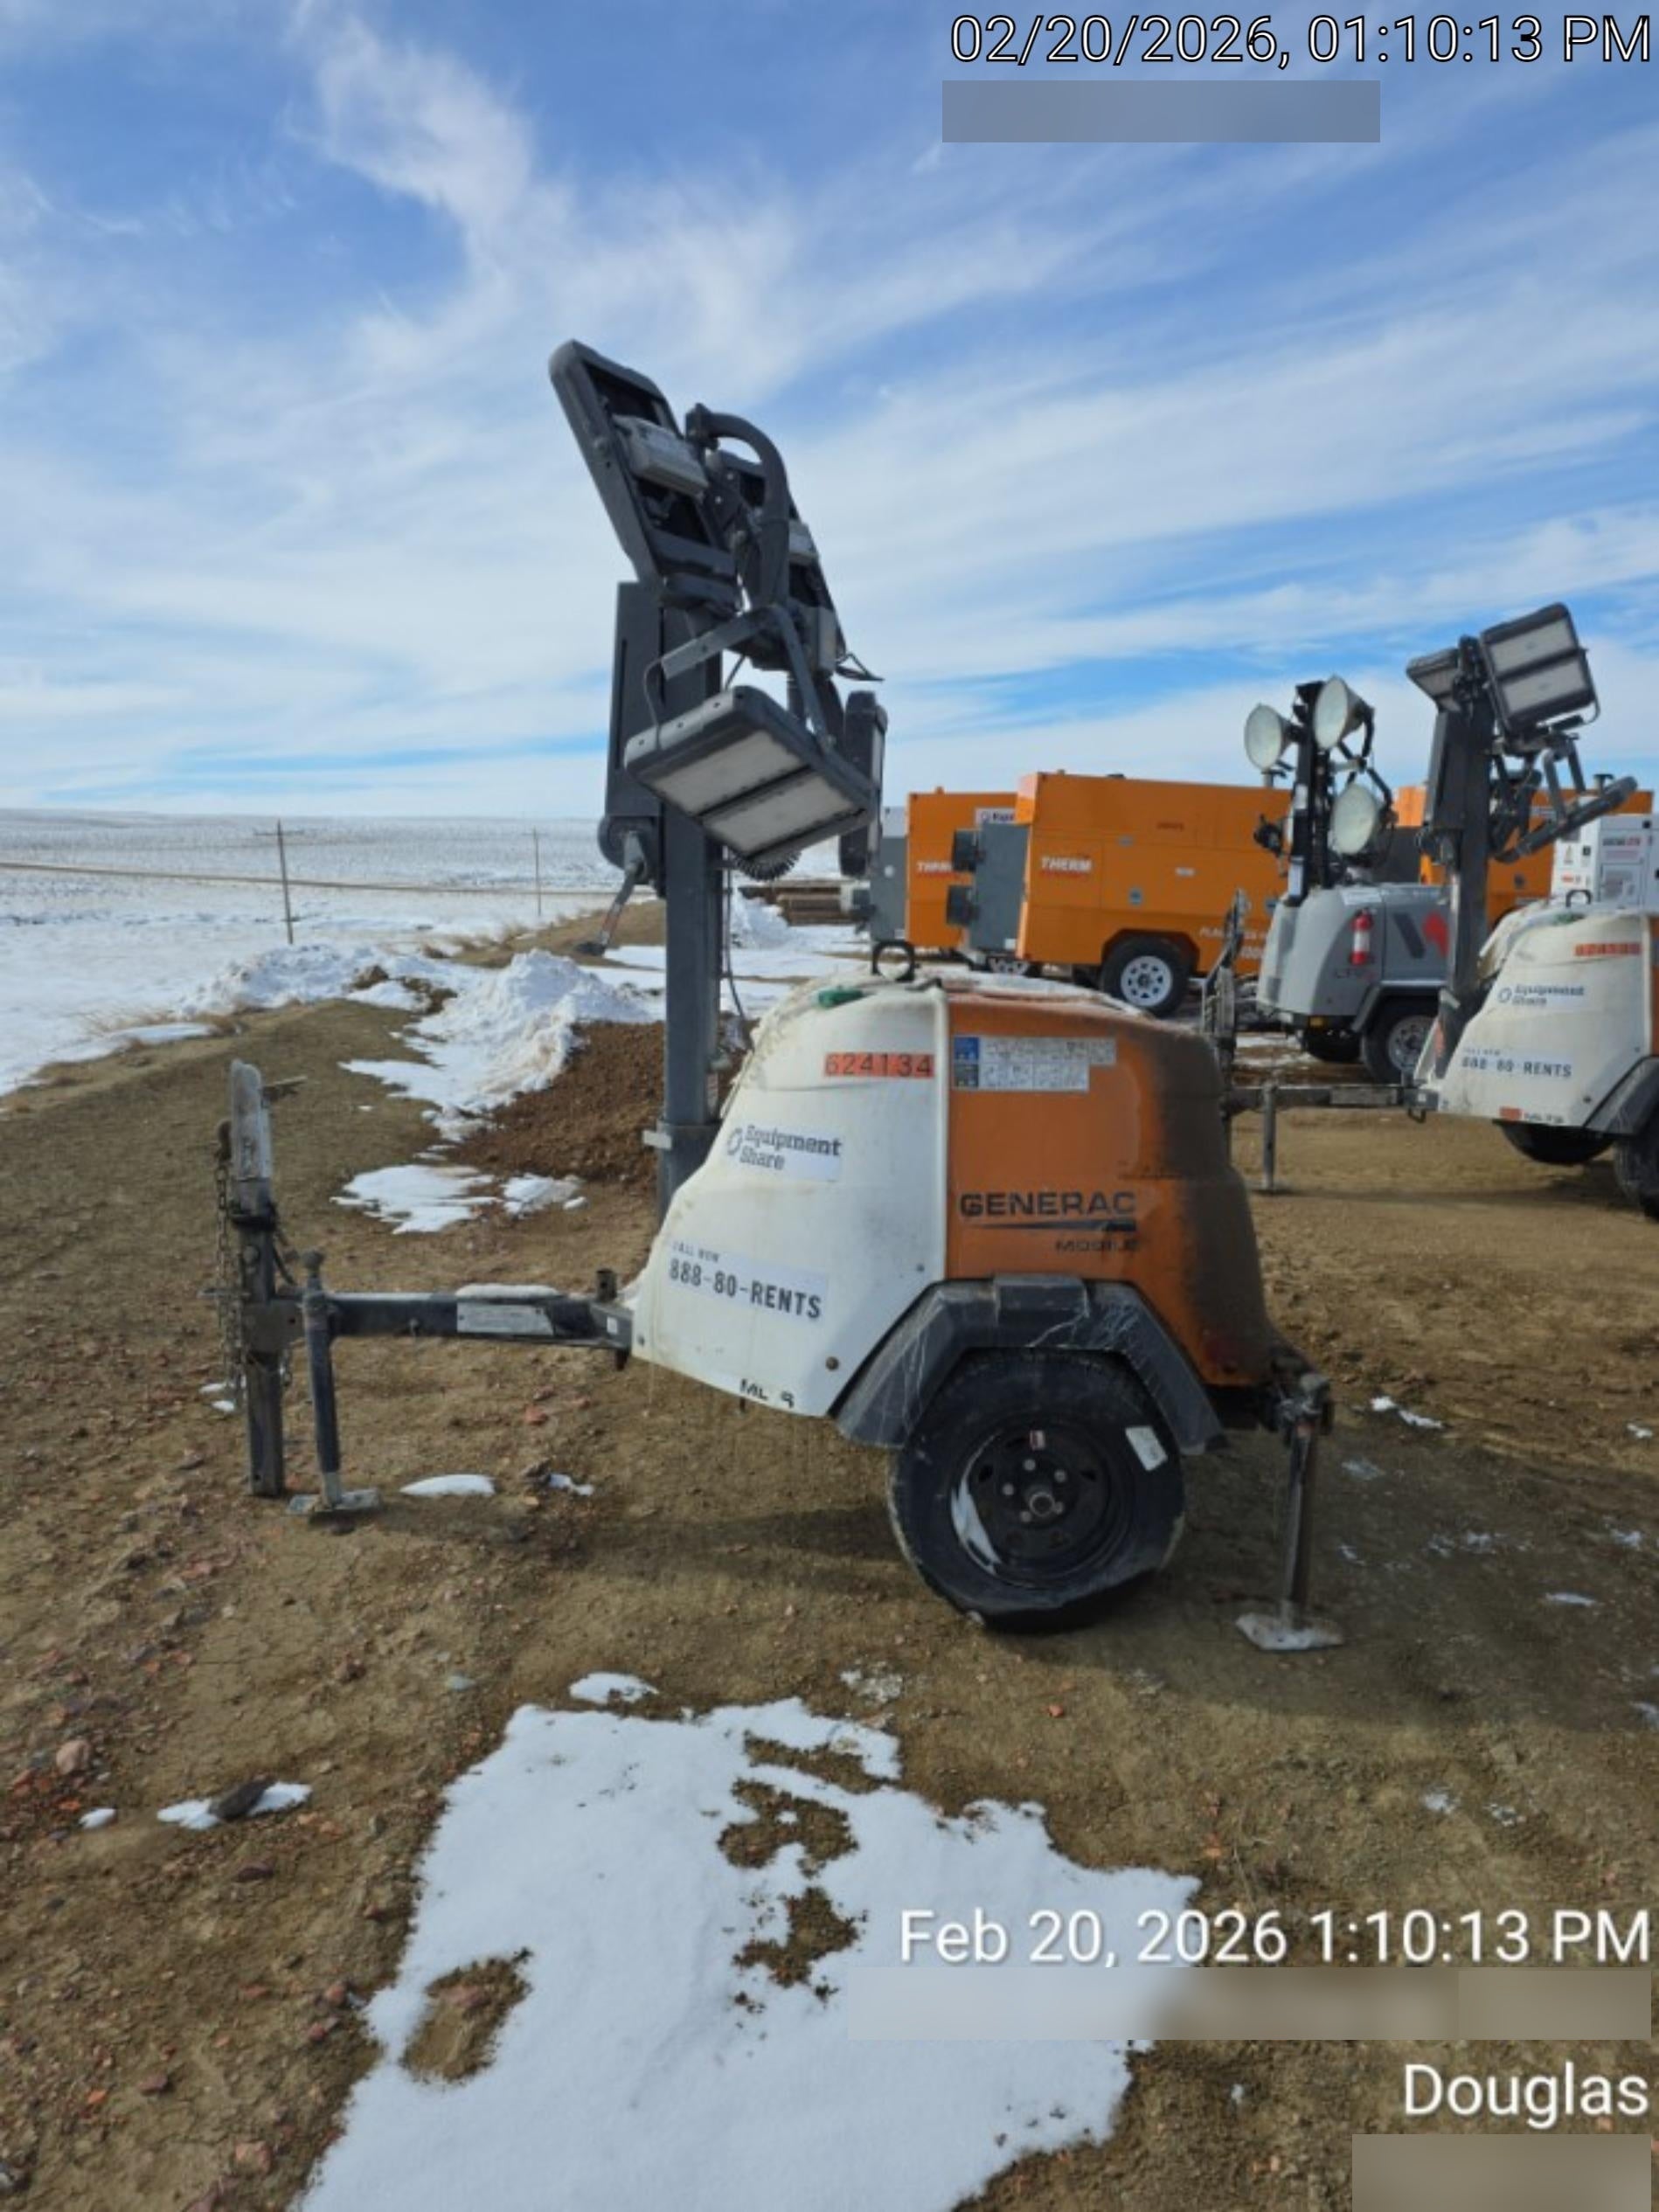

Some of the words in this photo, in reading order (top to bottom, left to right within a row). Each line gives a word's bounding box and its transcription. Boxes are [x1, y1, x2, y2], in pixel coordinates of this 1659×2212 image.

[825, 1052, 934, 1077] 624134
[745, 1125, 842, 1156] Equipment
[739, 1145, 785, 1171] Share
[960, 1191, 1135, 1217] GENERAC
